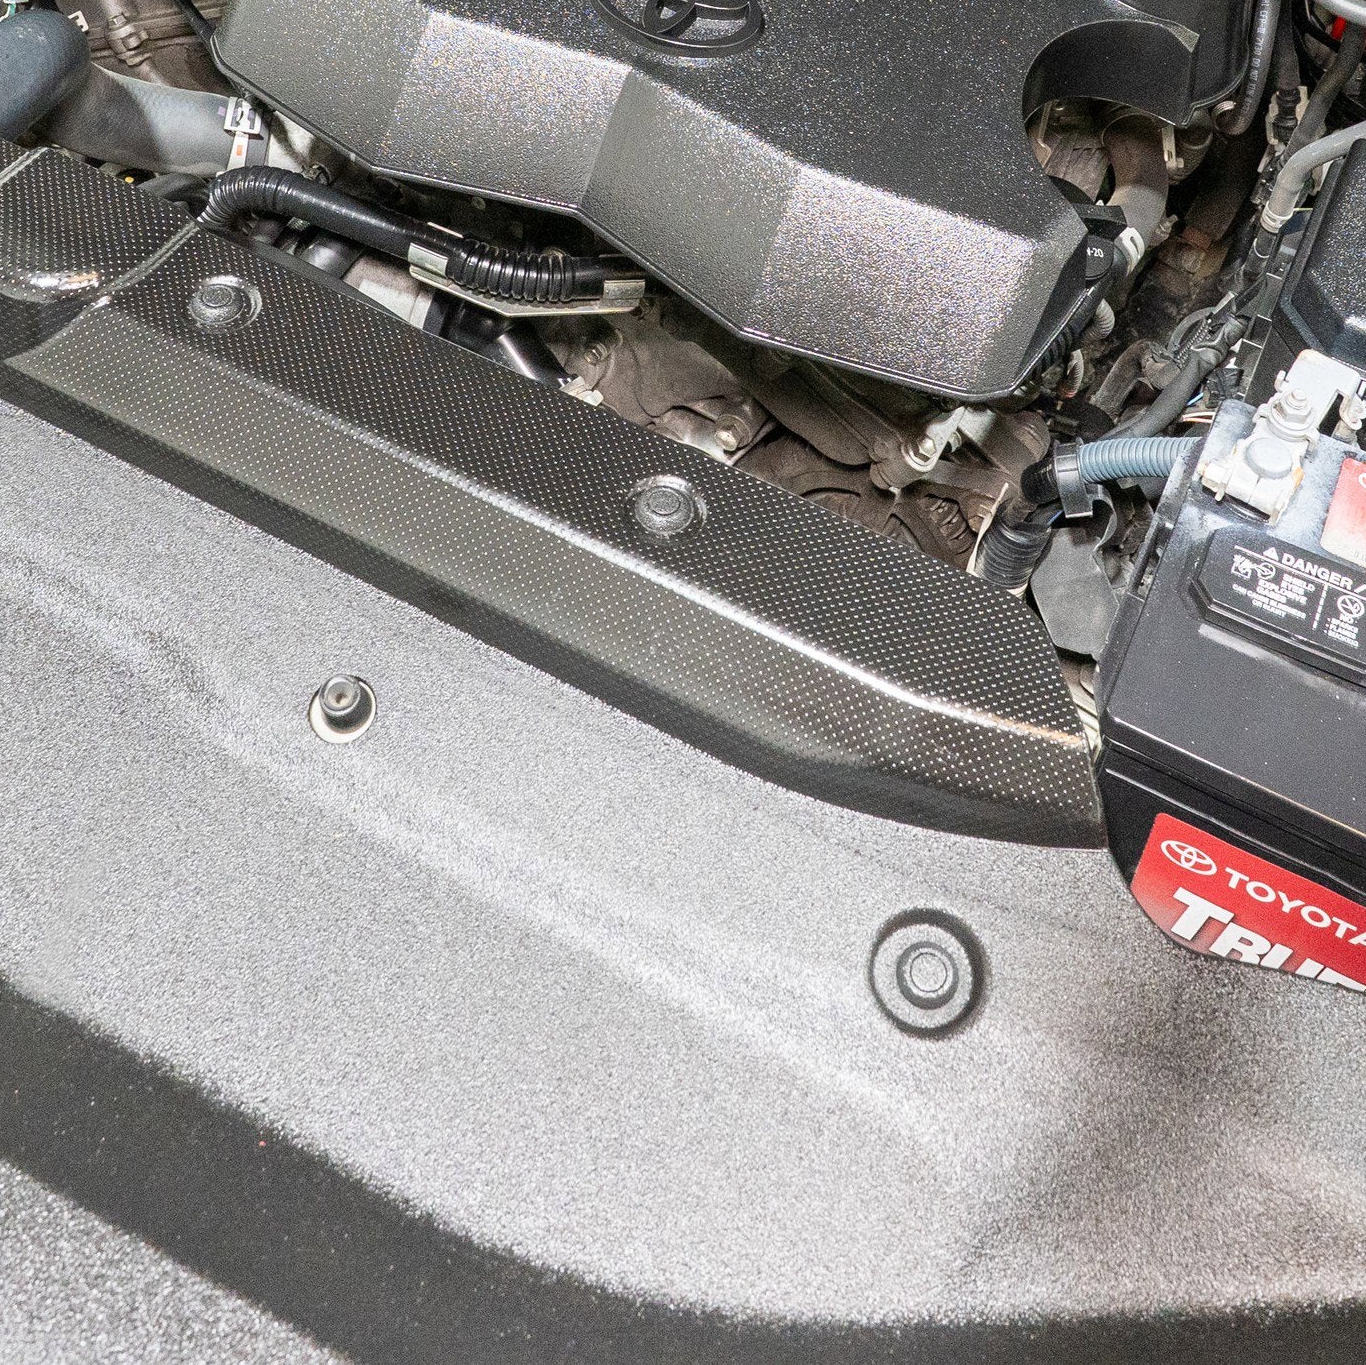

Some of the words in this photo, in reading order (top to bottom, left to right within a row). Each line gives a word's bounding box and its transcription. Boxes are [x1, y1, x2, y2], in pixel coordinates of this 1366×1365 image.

[1280, 552, 1354, 591] DANGER
[1257, 579, 1307, 605] EXPLOSIVE
[1281, 573, 1316, 593] SHIELD
[1255, 585, 1287, 604] GASES
[1246, 589, 1270, 604] CAUSE
[1268, 599, 1307, 620] BLINDNESS
[1330, 617, 1359, 634] SPARKS
[1338, 613, 1354, 624] NO
[1326, 629, 1359, 647] SMOKING
